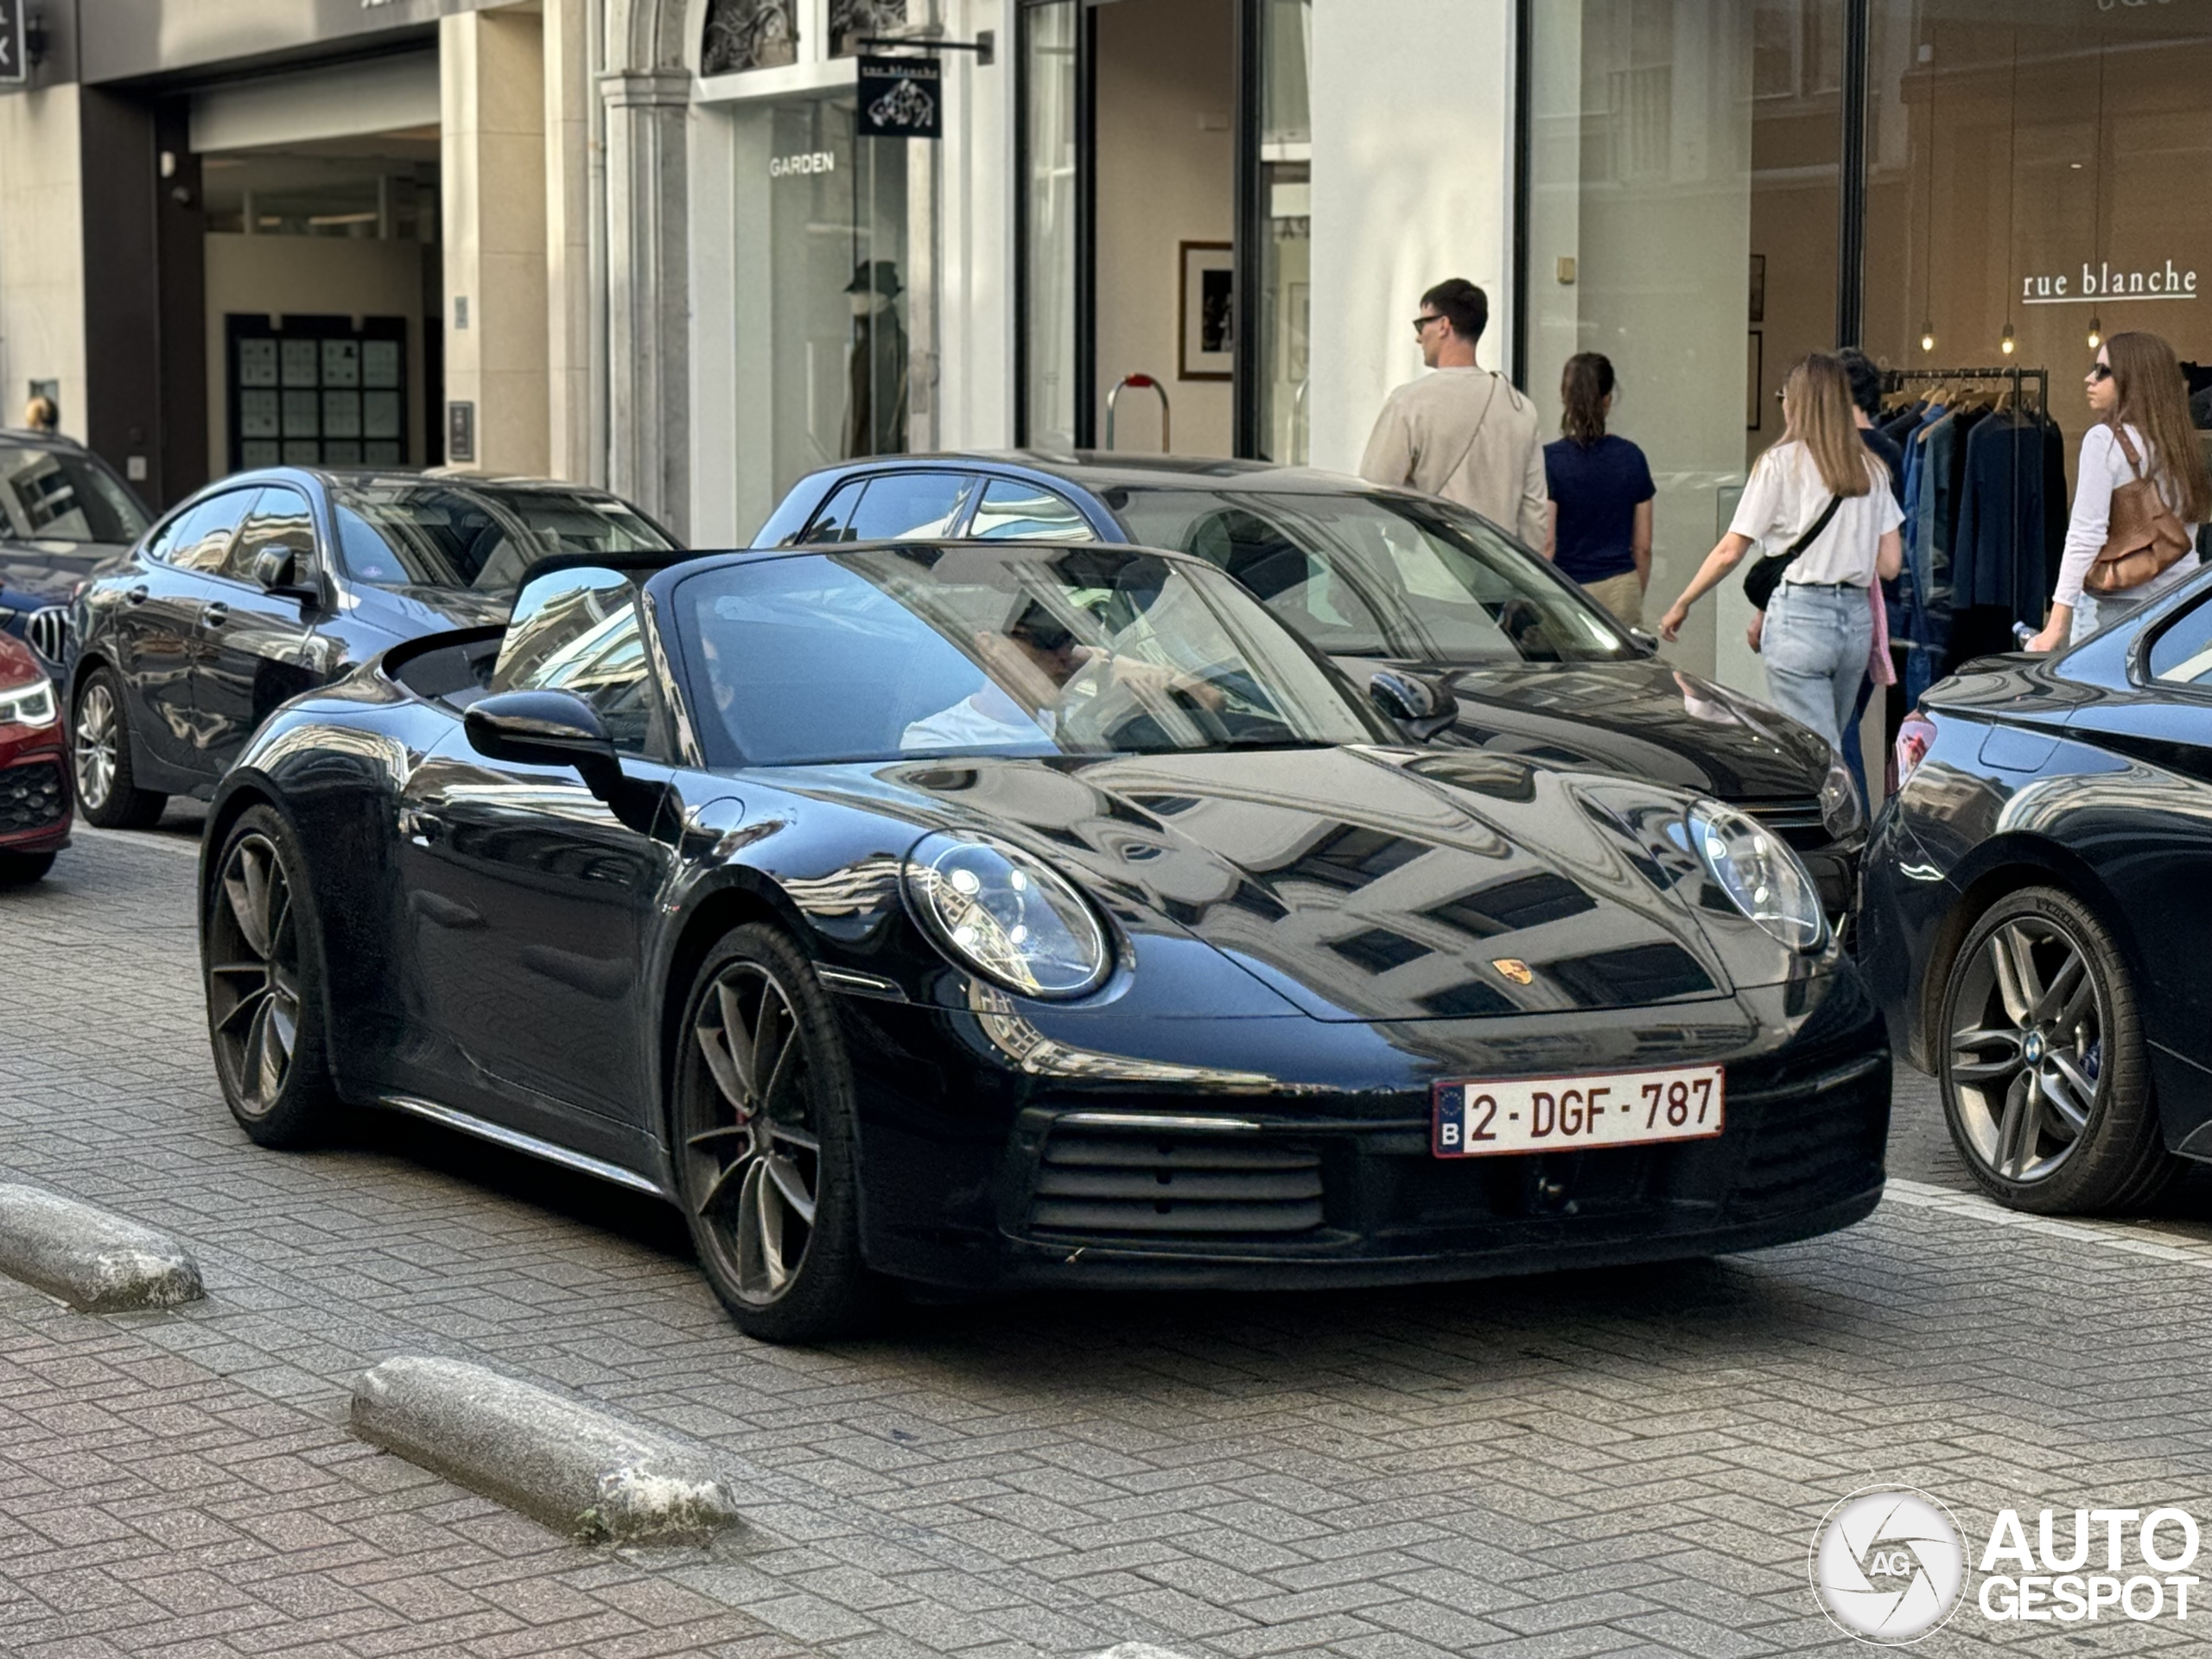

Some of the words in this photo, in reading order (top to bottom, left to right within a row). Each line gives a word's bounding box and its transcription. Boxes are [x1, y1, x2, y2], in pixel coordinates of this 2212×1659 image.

[769, 150, 835, 178] GARDEN
[2023, 275, 2068, 296] rue
[2082, 259, 2197, 295] blanche
[1442, 1122, 1460, 1146] B
